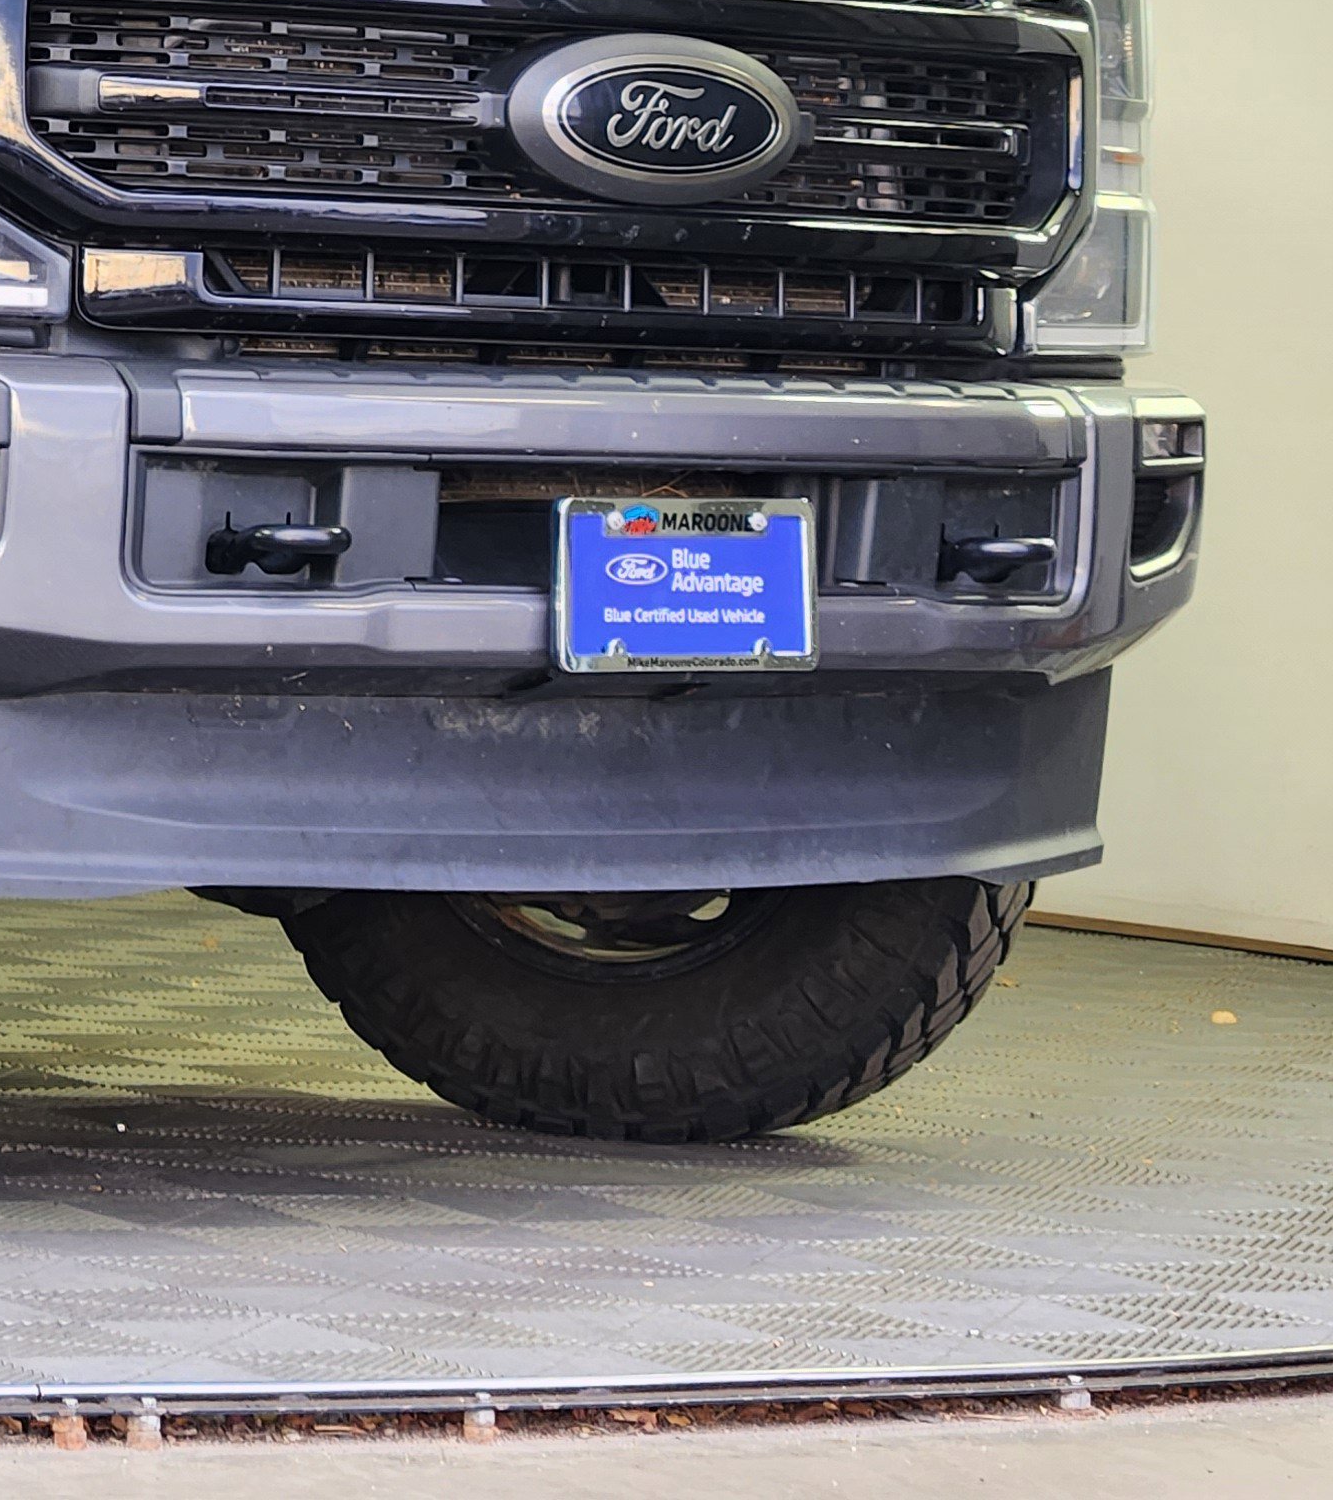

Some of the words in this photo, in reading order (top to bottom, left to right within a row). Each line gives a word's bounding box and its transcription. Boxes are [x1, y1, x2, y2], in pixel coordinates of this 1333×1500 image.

[606, 80, 737, 152] Ford
[617, 558, 657, 579] Ford
[671, 548, 710, 569] Blue
[671, 571, 764, 597] Advantage
[604, 607, 632, 623] Blue
[634, 607, 685, 623] Certified
[688, 608, 719, 623] Used
[721, 608, 765, 623] Vehicle
